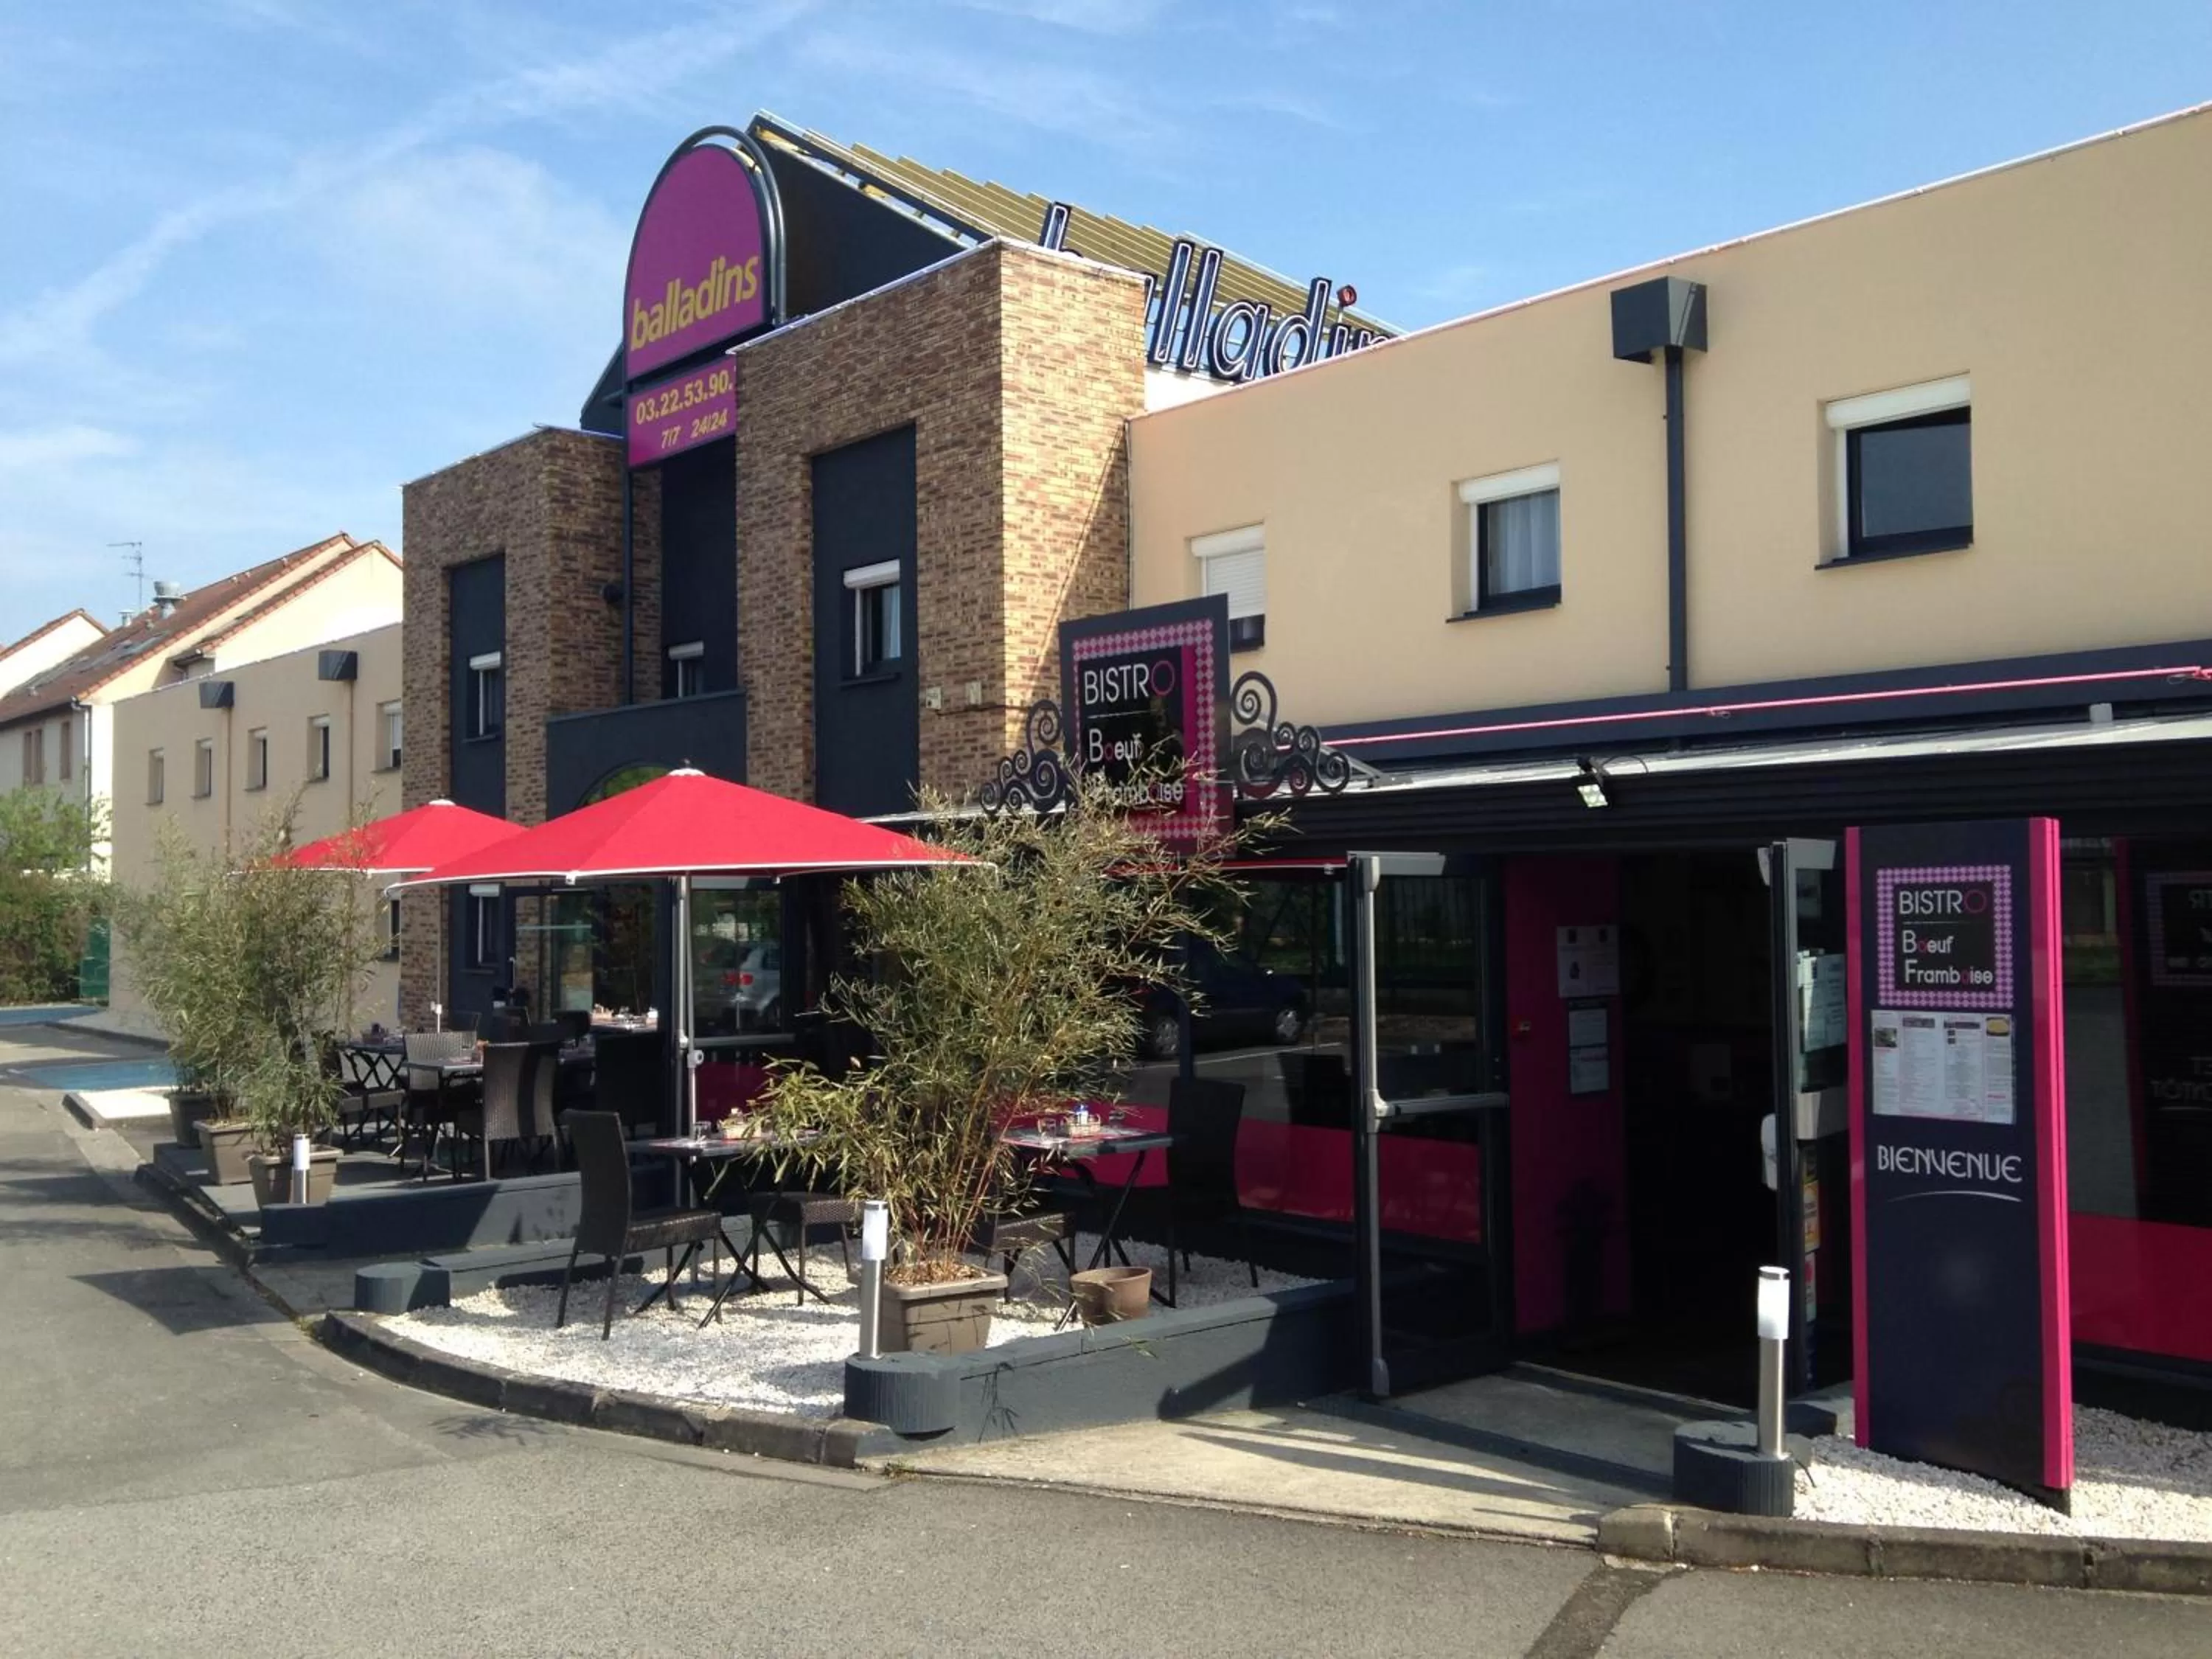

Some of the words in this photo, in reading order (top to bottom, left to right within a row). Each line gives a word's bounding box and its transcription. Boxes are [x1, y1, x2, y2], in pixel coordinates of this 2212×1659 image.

[630, 255, 759, 351] balladins
[636, 366, 737, 425] 03.22.53.90.
[690, 408, 728, 439] 24/24
[1084, 661, 1175, 705] BISTRO
[1899, 889, 1987, 914] BISTRO
[1902, 930, 1954, 953] Boeuf
[1905, 959, 1994, 984] Framboise
[1878, 1144, 2023, 1183] BIENVENUE
